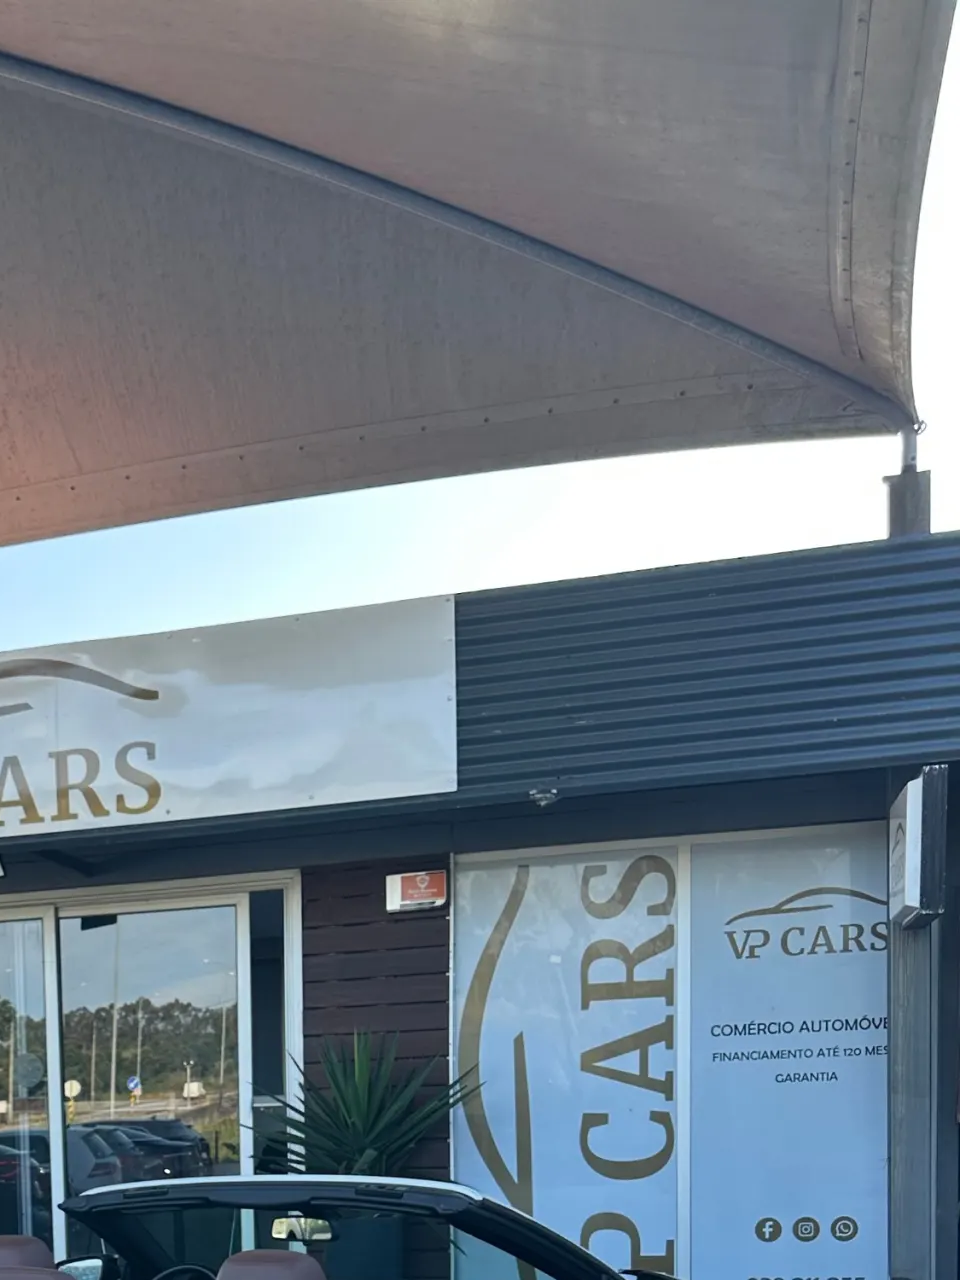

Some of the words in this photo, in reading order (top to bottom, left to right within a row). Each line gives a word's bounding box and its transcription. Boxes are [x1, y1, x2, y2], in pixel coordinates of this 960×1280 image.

[724, 929, 771, 960] VP
[780, 921, 888, 956] CARS
[580, 855, 677, 1180] CARS
[710, 1020, 795, 1038] COMÉRCIO
[712, 1048, 814, 1063] FINANCIAMENTO
[817, 1045, 840, 1059] ATÉ
[843, 1047, 862, 1057] 120
[775, 1071, 838, 1084] GARANTIA
